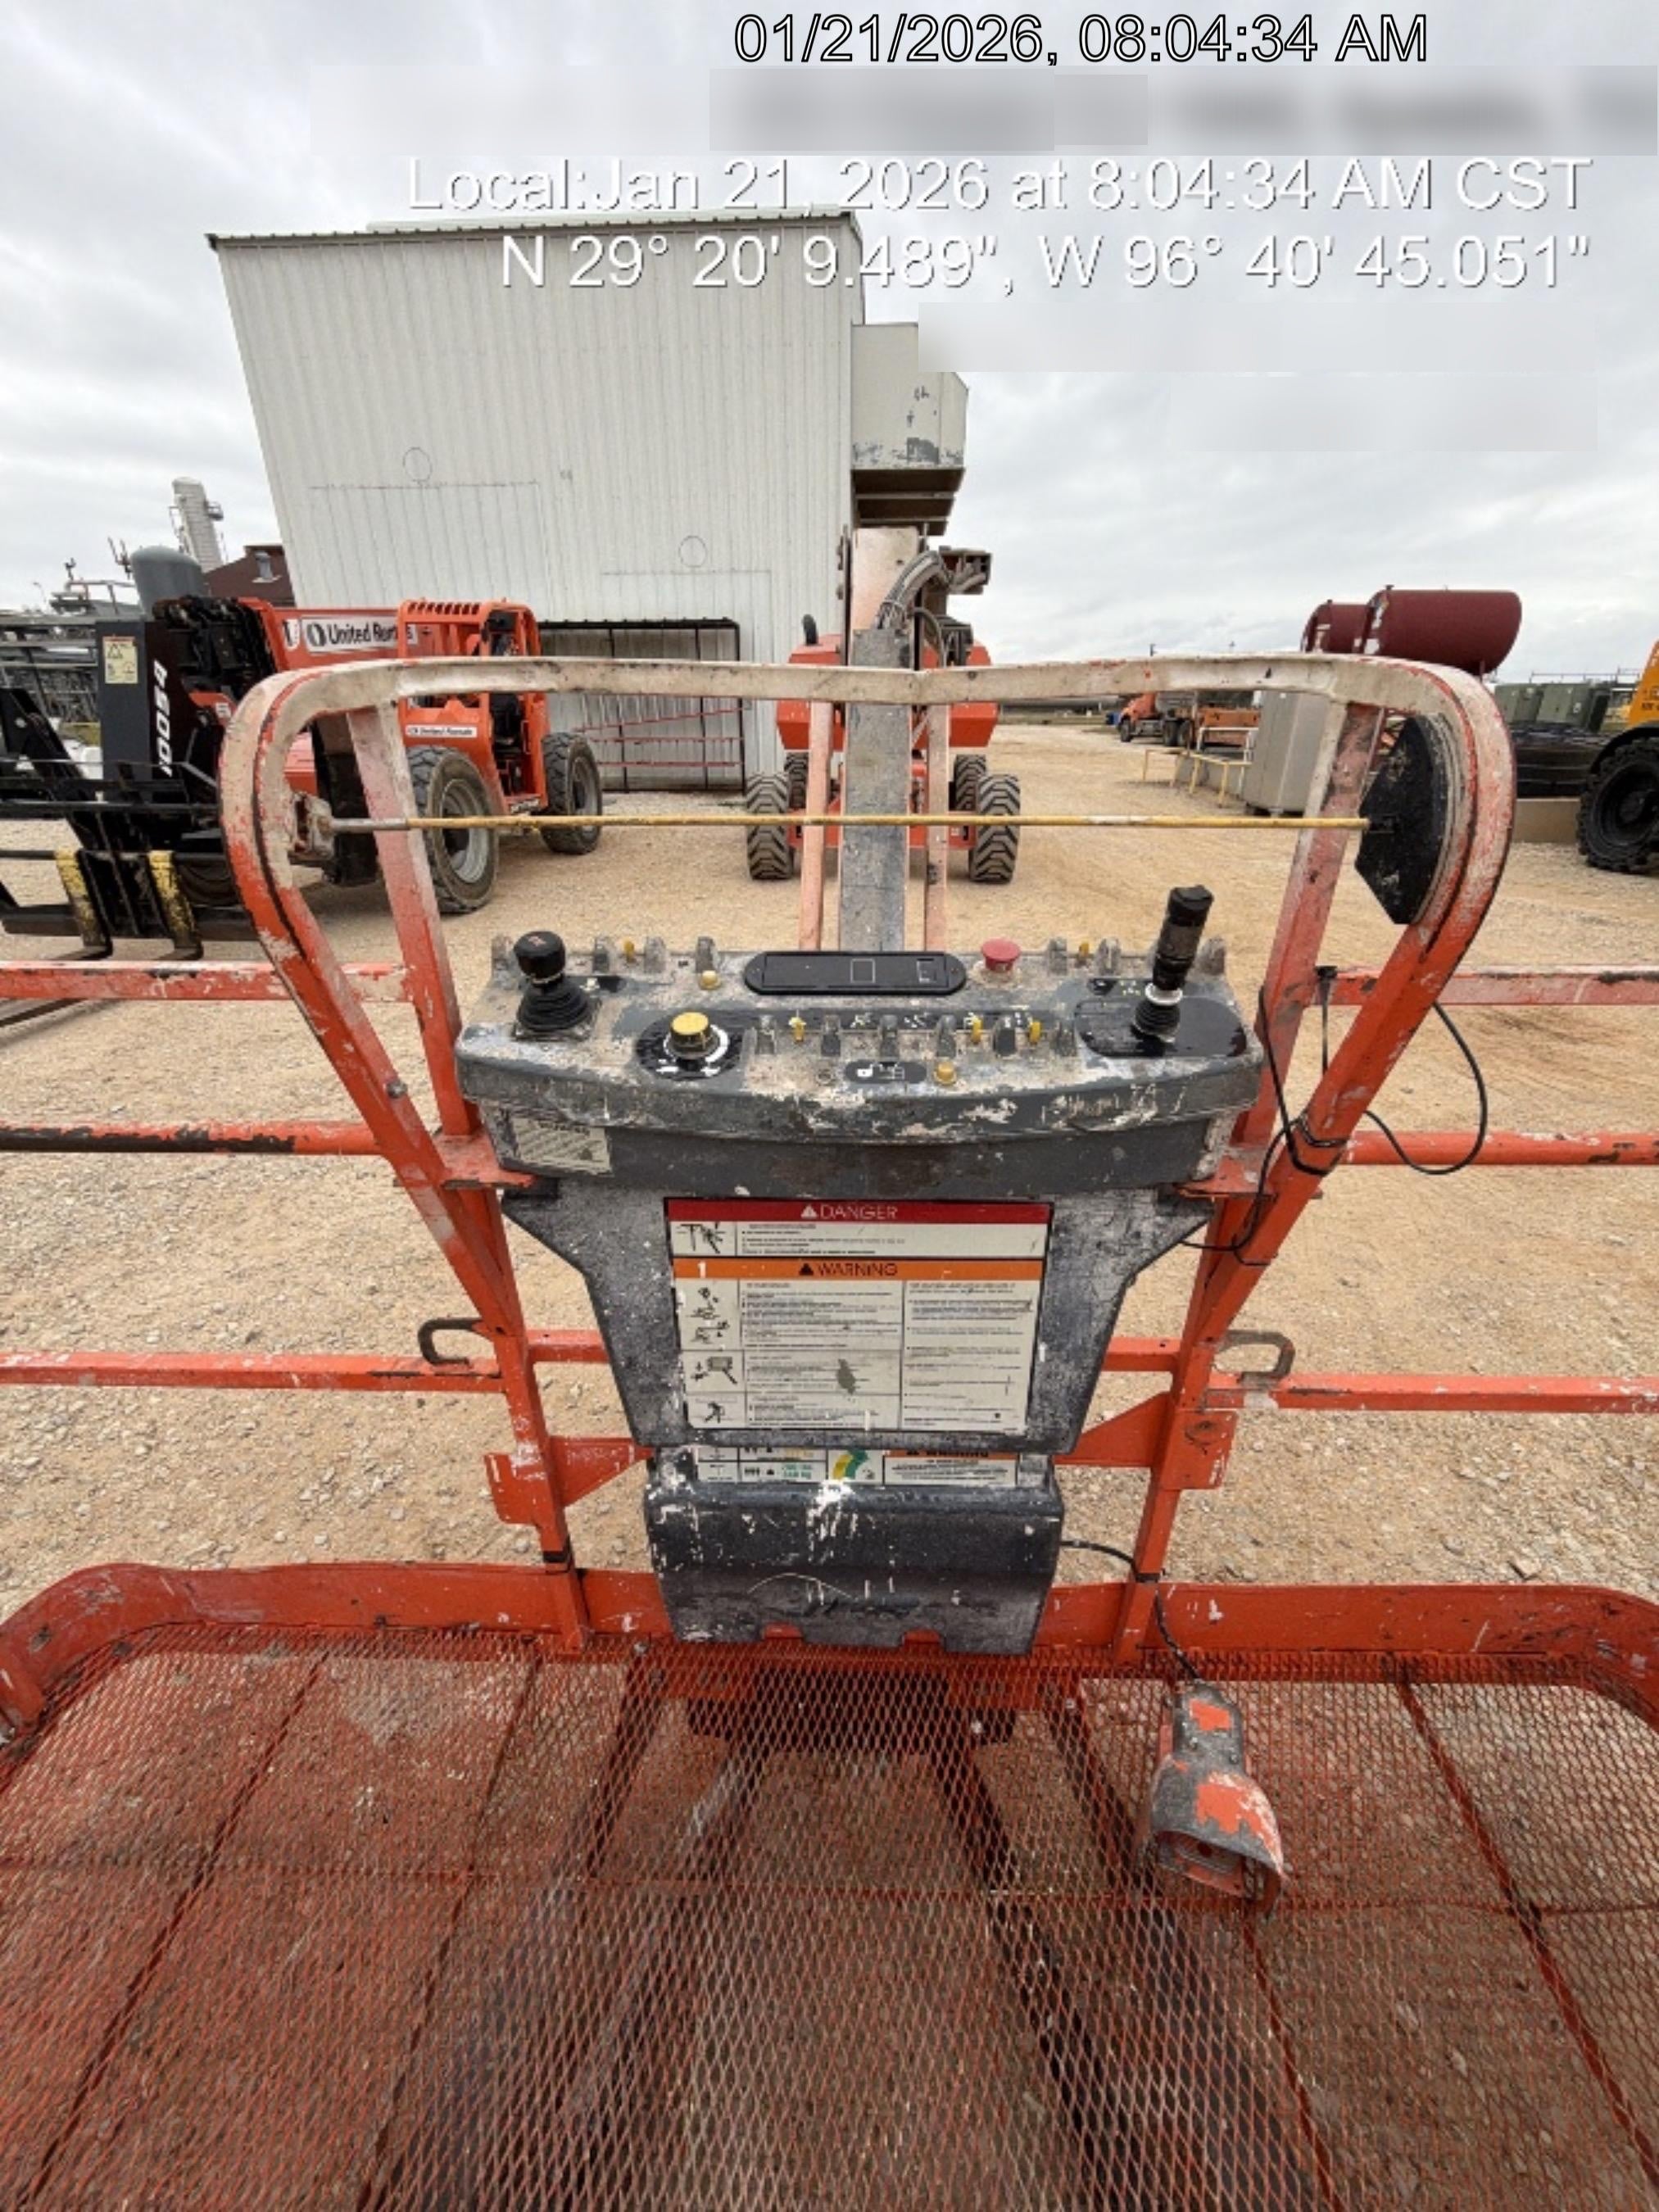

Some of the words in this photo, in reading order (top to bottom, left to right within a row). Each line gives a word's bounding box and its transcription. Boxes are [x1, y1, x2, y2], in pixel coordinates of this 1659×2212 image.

[329, 623, 371, 644] United
[820, 1204, 899, 1220] DANGER
[818, 1262, 899, 1277] WARNING
